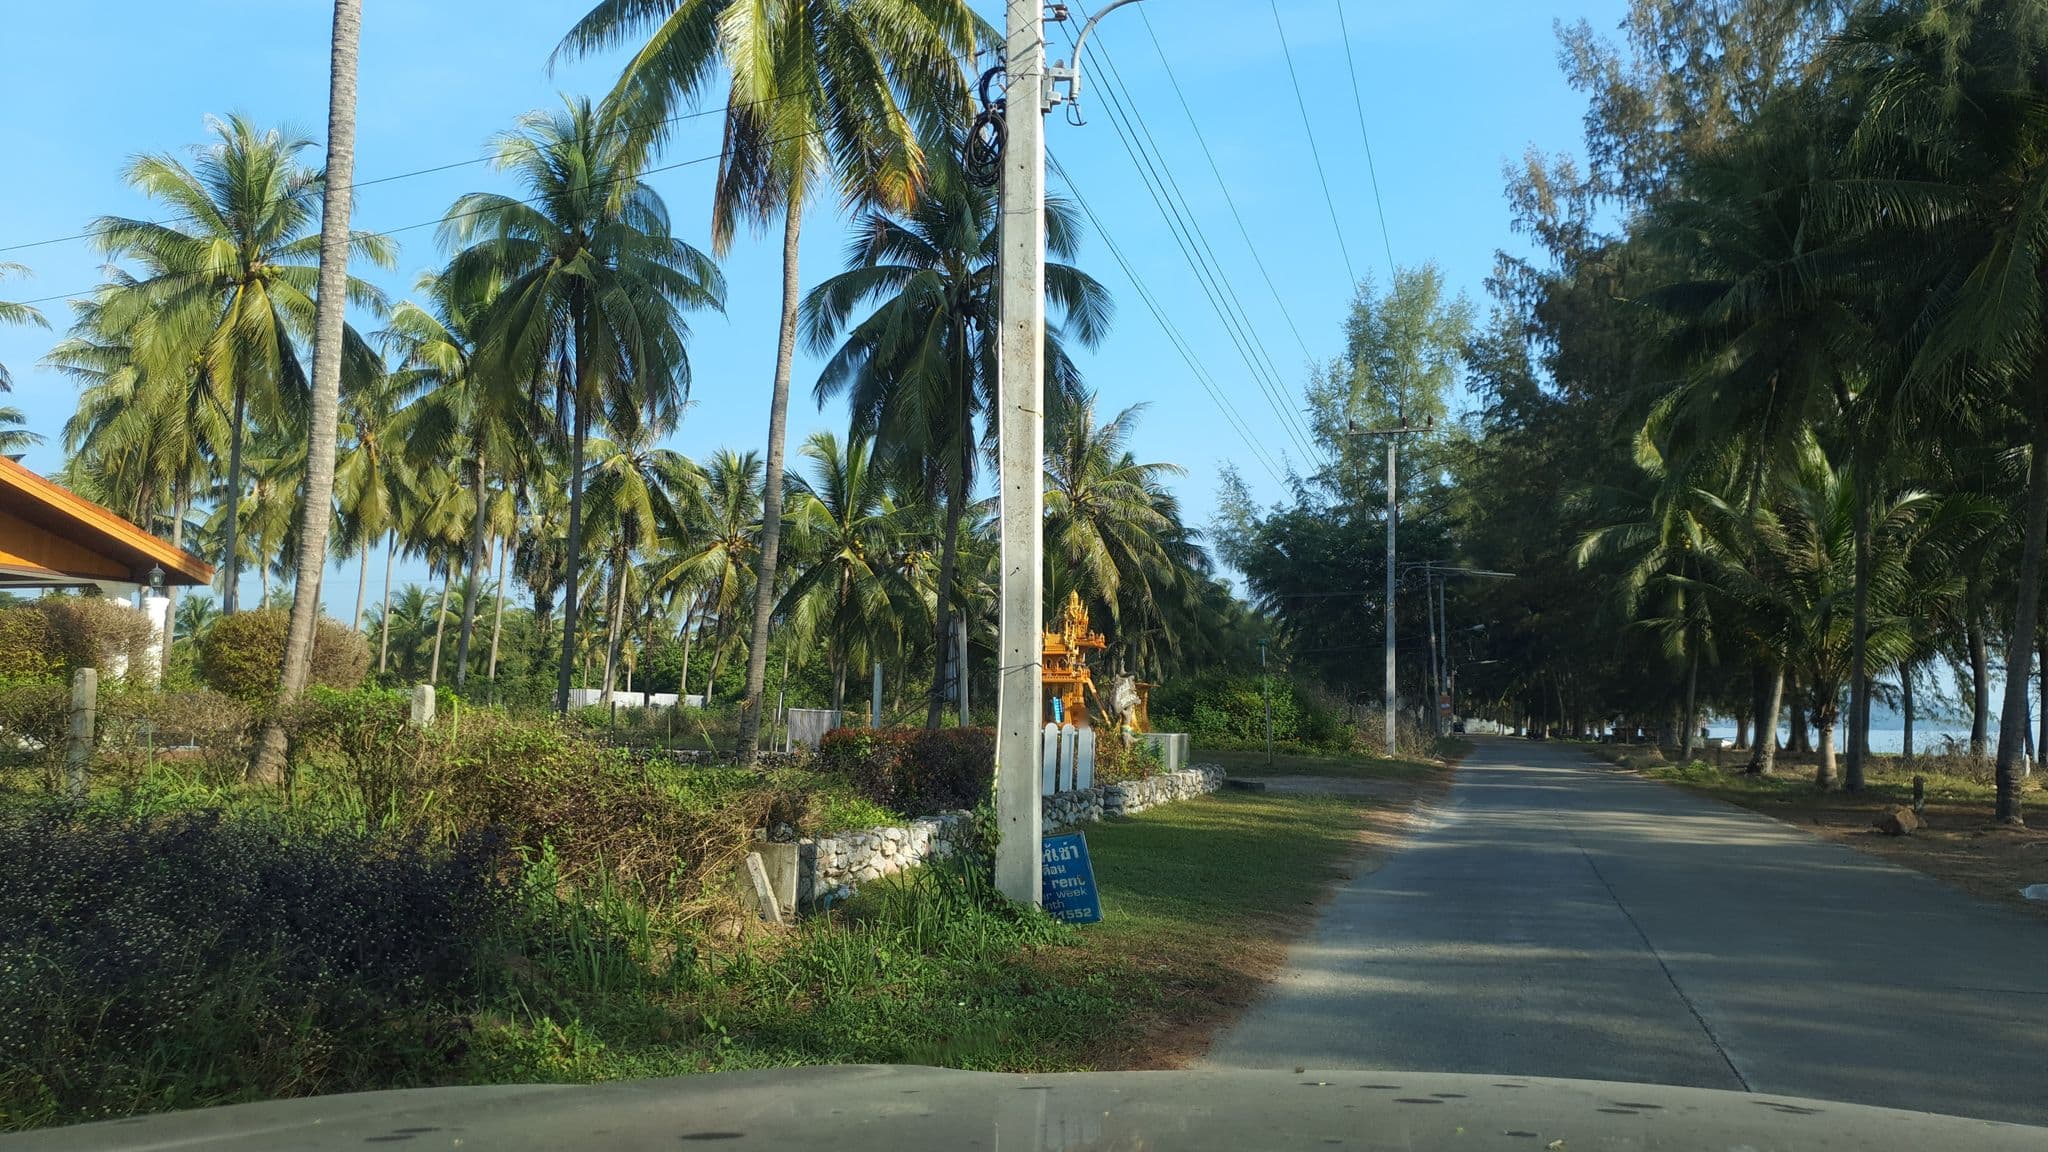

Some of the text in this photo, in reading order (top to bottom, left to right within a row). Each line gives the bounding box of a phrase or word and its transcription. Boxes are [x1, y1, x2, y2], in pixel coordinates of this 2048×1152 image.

[1051, 875, 1086, 889] rent
[1056, 887, 1088, 899] week
[1049, 907, 1092, 920] 71552
